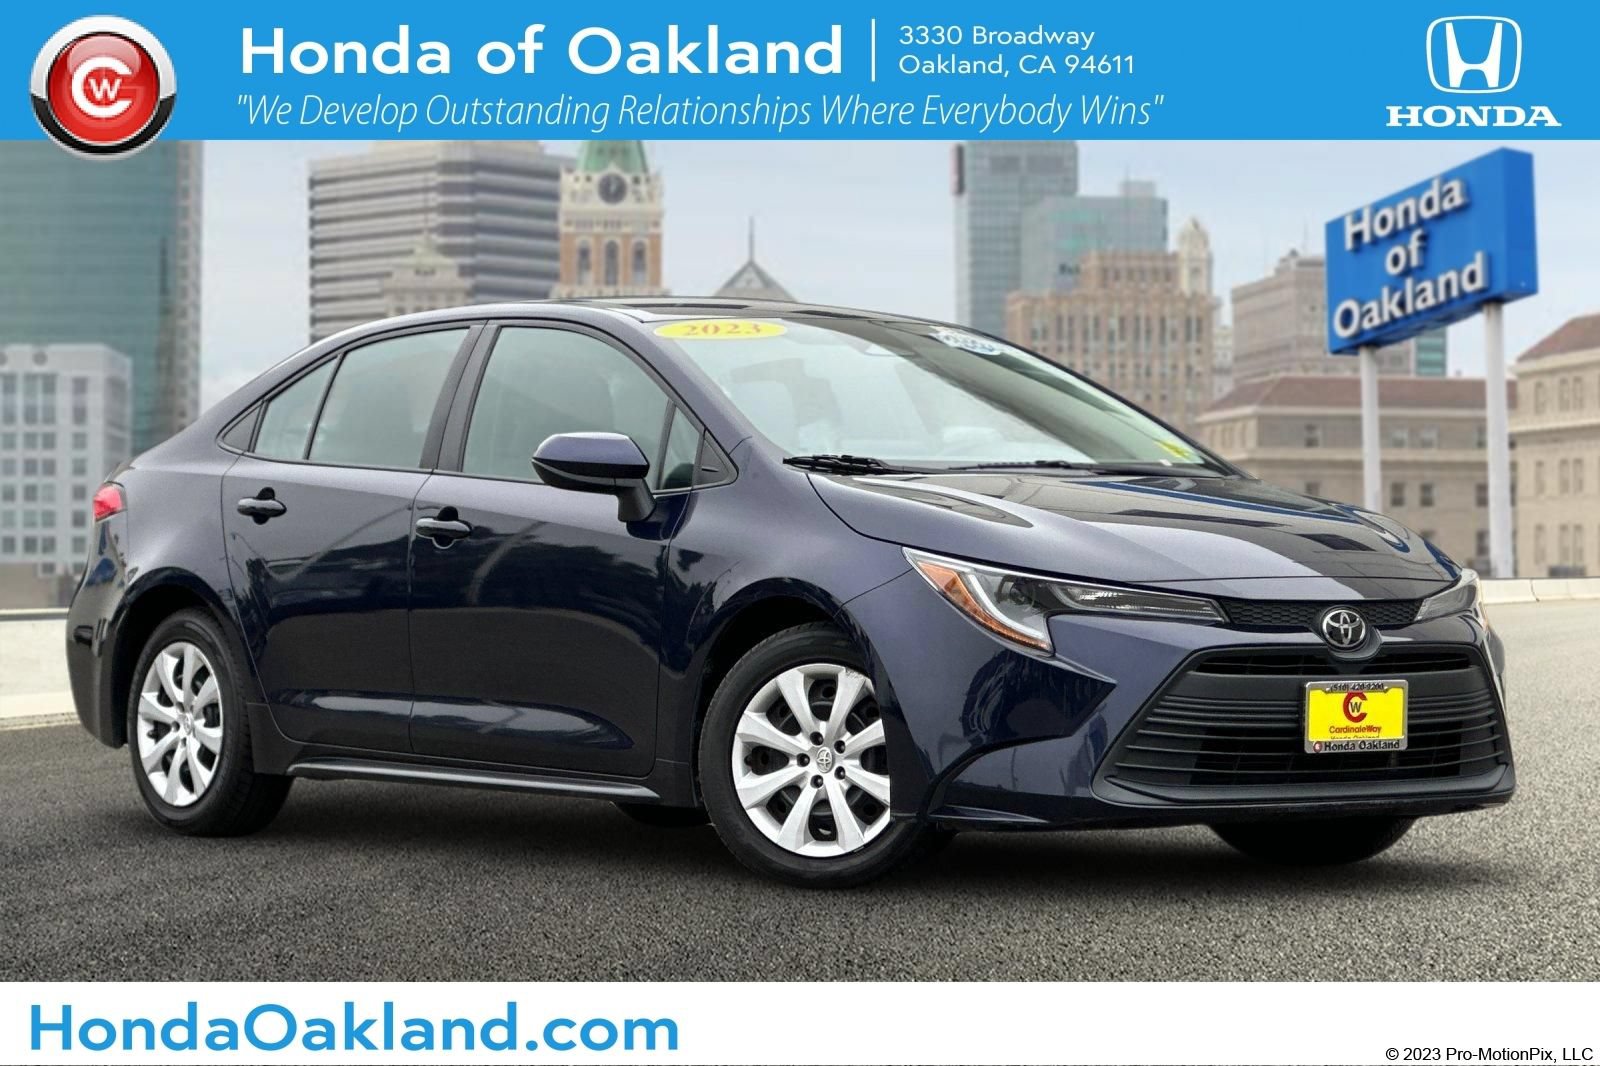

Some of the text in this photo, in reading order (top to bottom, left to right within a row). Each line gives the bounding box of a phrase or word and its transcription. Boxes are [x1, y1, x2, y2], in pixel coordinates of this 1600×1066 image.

[1344, 176, 1466, 251] Honda
[1386, 228, 1426, 275] of
[1333, 251, 1487, 338] Oakland
[683, 323, 761, 336] 2023
[1329, 724, 1382, 735] CardinaleWay
[1324, 740, 1400, 751] Honda Oakland
